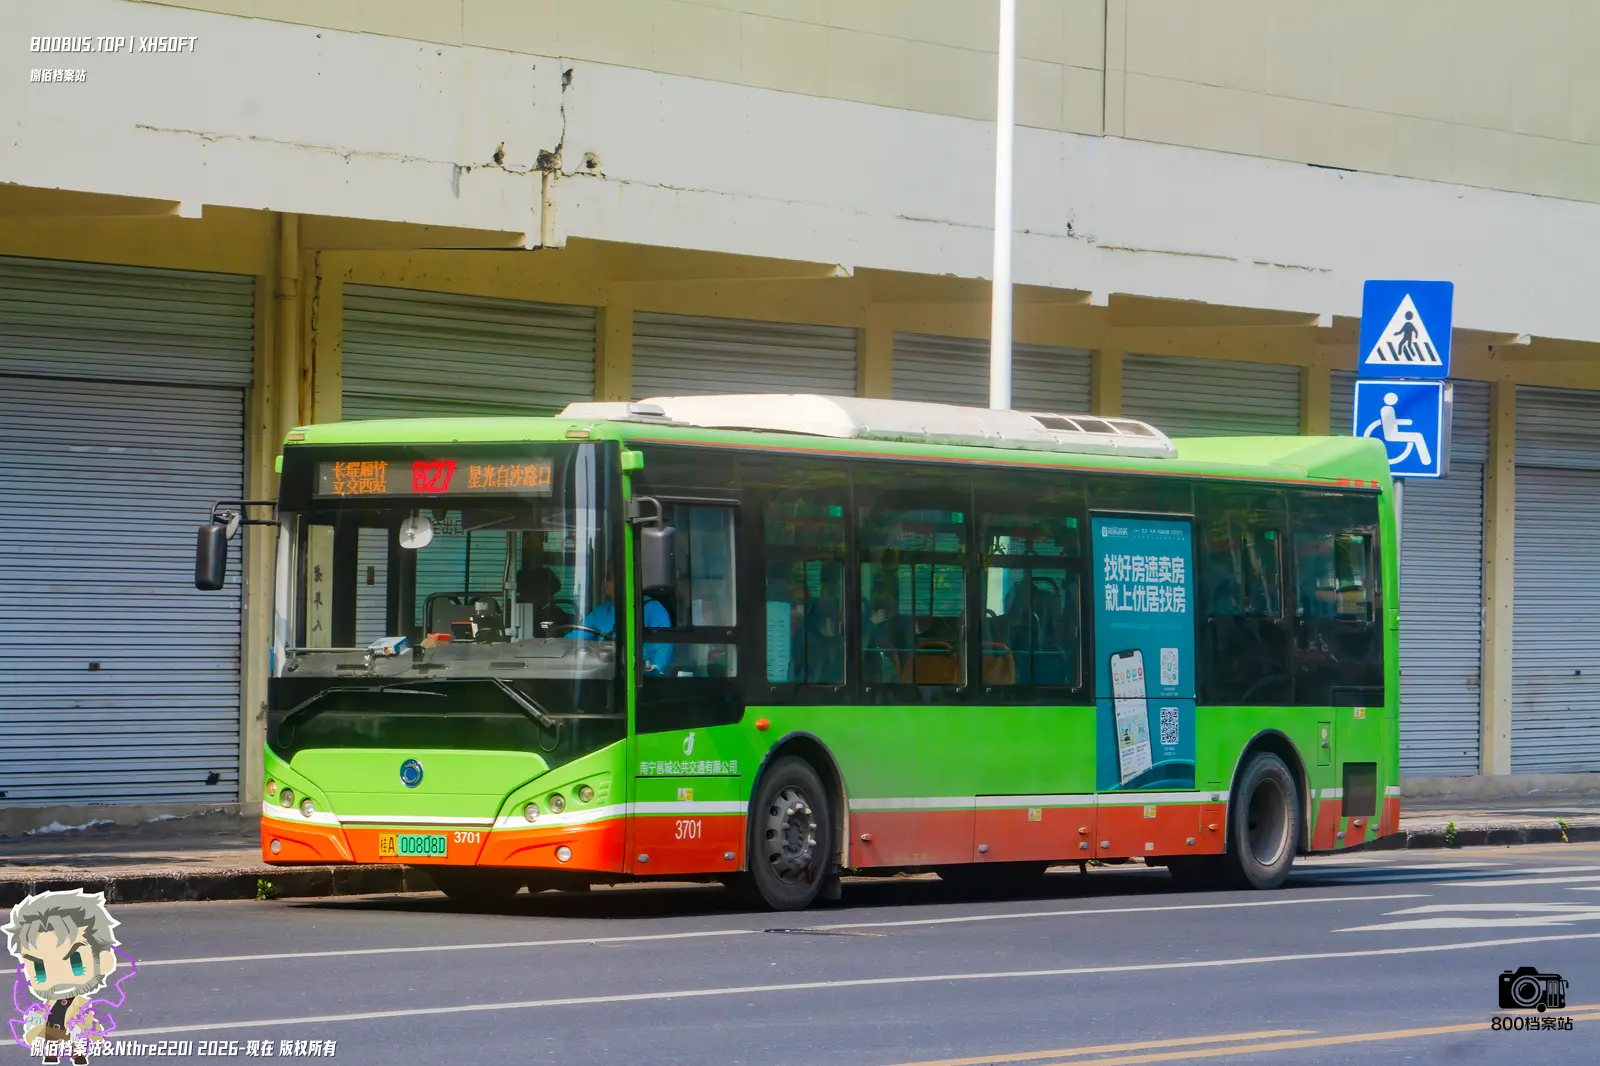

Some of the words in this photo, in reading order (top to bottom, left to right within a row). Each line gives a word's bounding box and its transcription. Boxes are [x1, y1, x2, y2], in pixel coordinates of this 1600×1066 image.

[332, 478, 387, 495] 立交西站
[412, 460, 457, 493] B27
[467, 463, 551, 489] 星光白沙路口
[1103, 553, 1185, 584] 找好房速卖房
[1104, 583, 1186, 613] 就上优居找房
[639, 760, 738, 775] 南宁邕城公共交通有限公司
[454, 831, 481, 844] 3701
[675, 819, 702, 839] 3701
